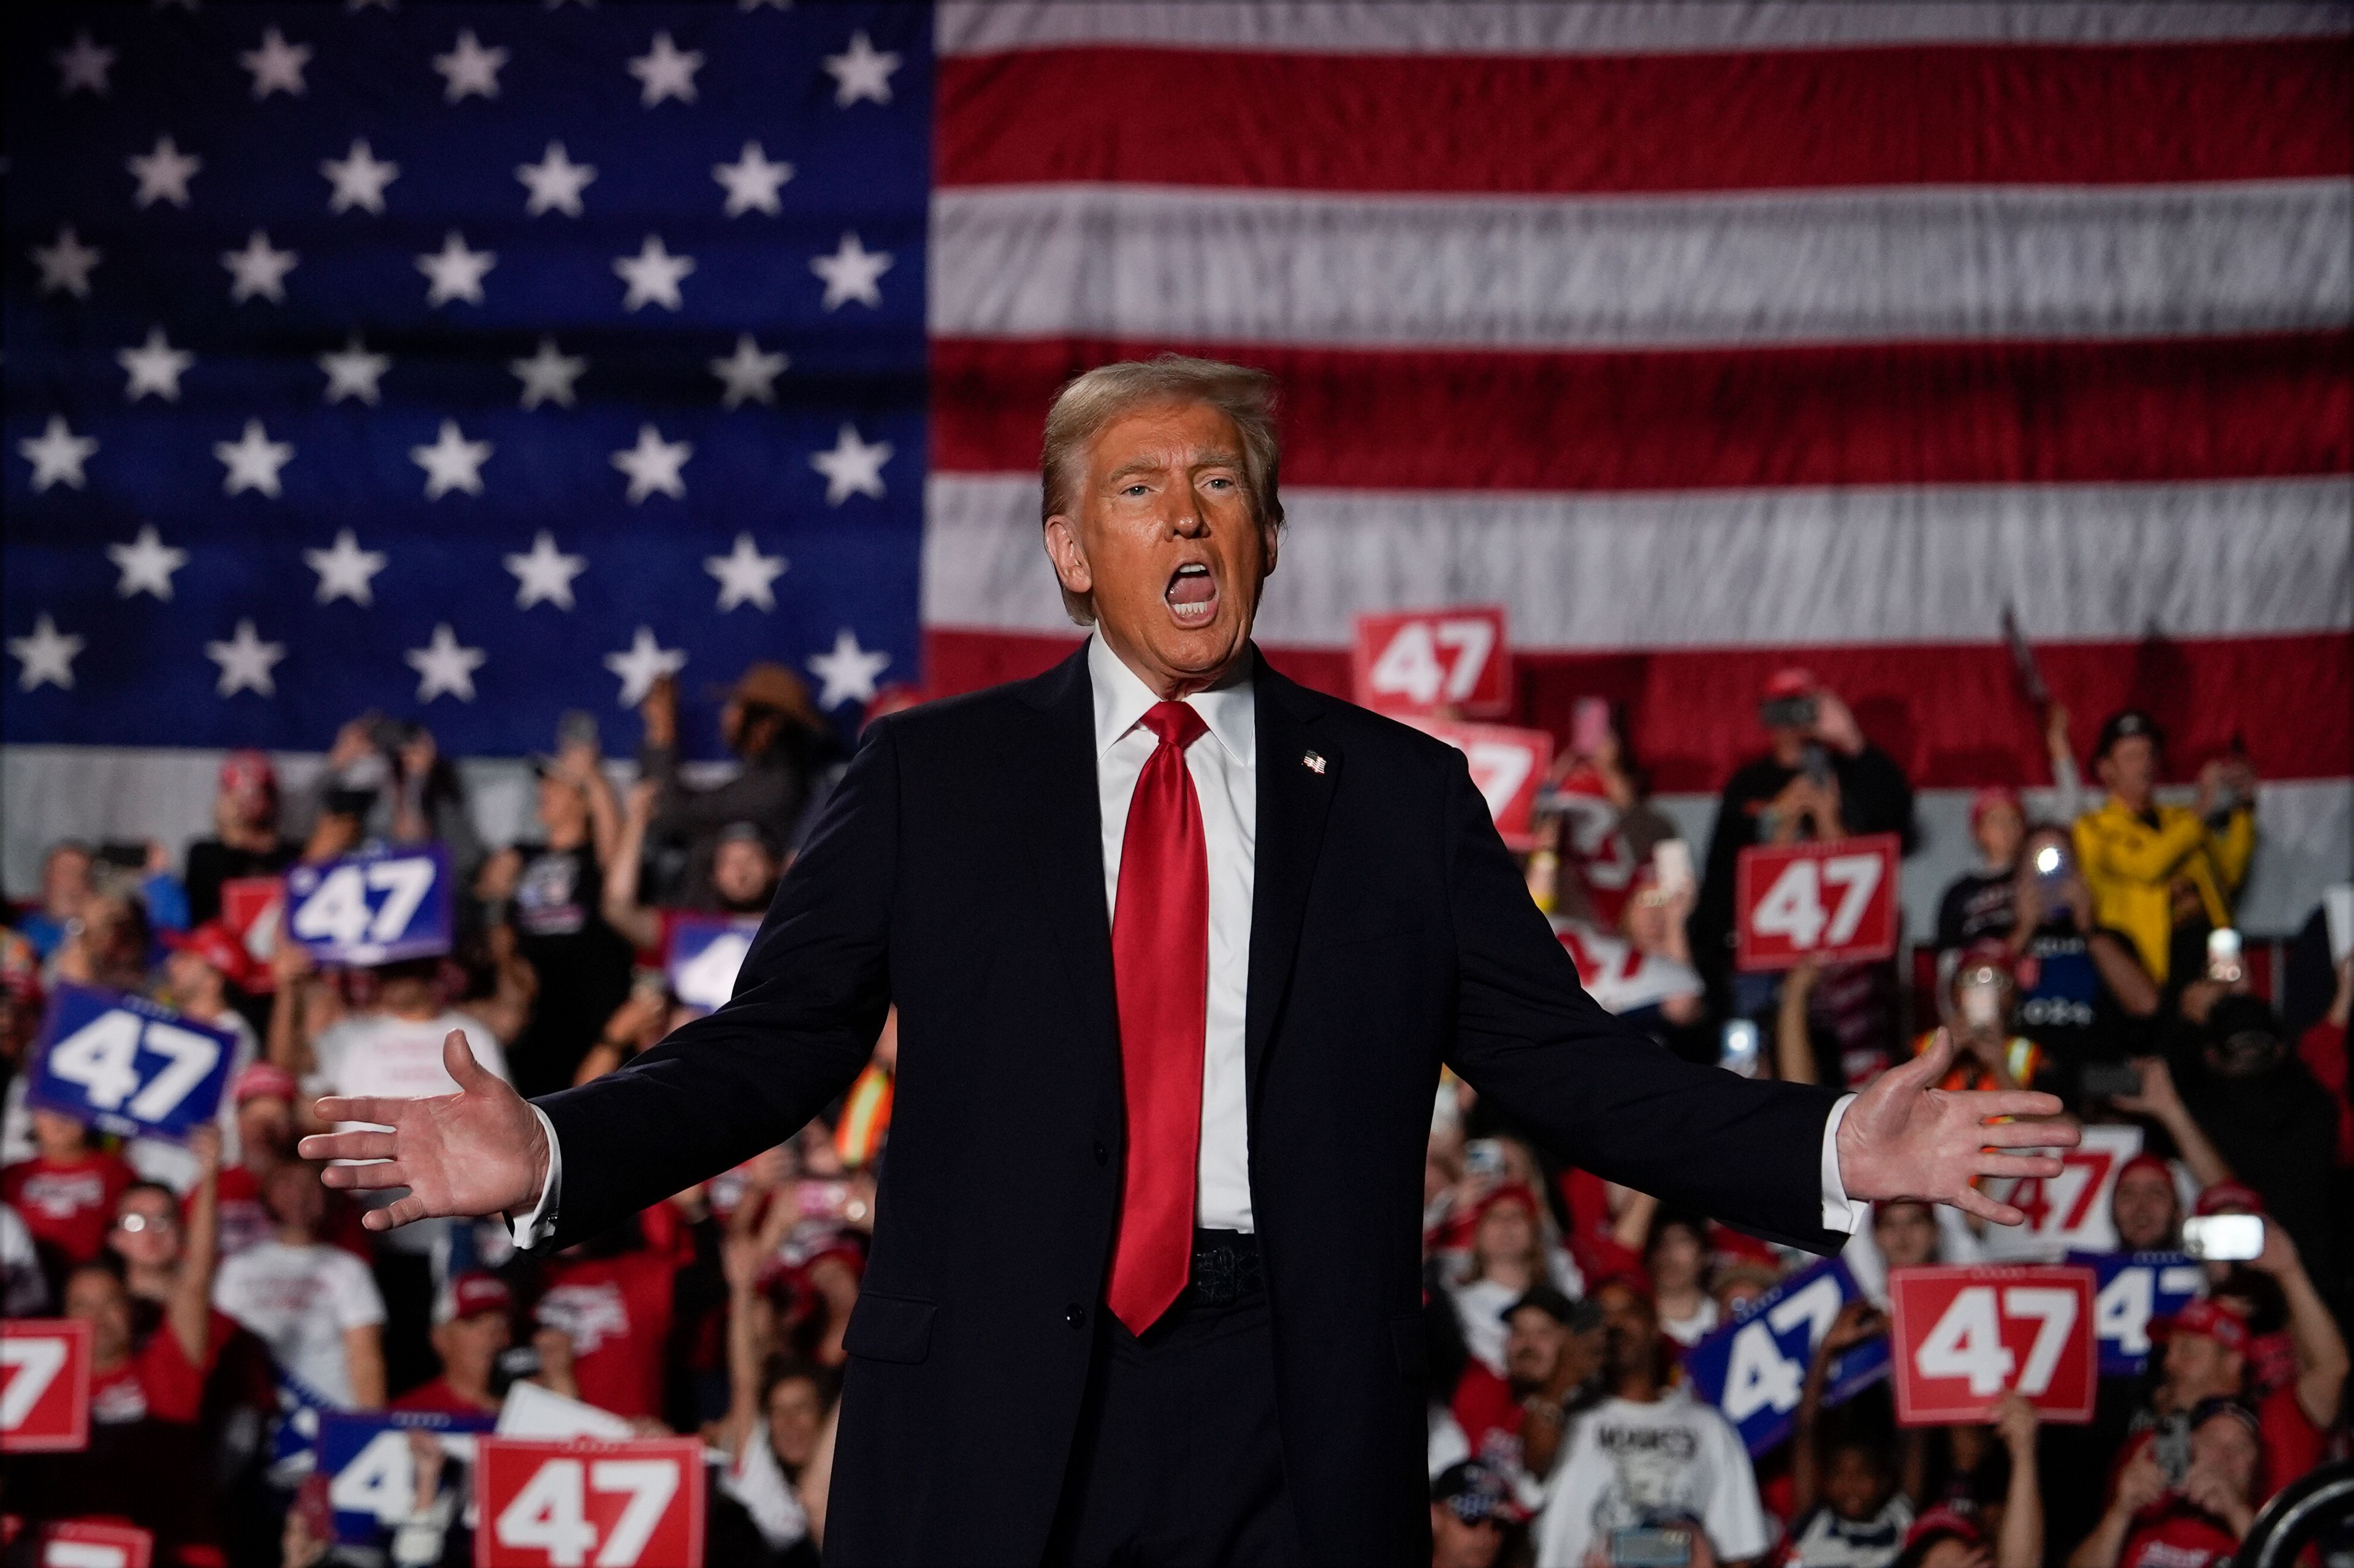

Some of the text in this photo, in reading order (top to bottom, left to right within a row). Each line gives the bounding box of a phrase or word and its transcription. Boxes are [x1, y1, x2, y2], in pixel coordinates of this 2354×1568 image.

[1369, 619, 1497, 704] 47
[292, 856, 439, 942] 47
[1752, 853, 1886, 948] 47
[48, 1008, 223, 1124] 47
[2006, 1155, 2114, 1231] 47
[1721, 1275, 1844, 1423] 47
[1914, 1286, 2079, 1397] 47
[495, 1457, 680, 1568] 47
